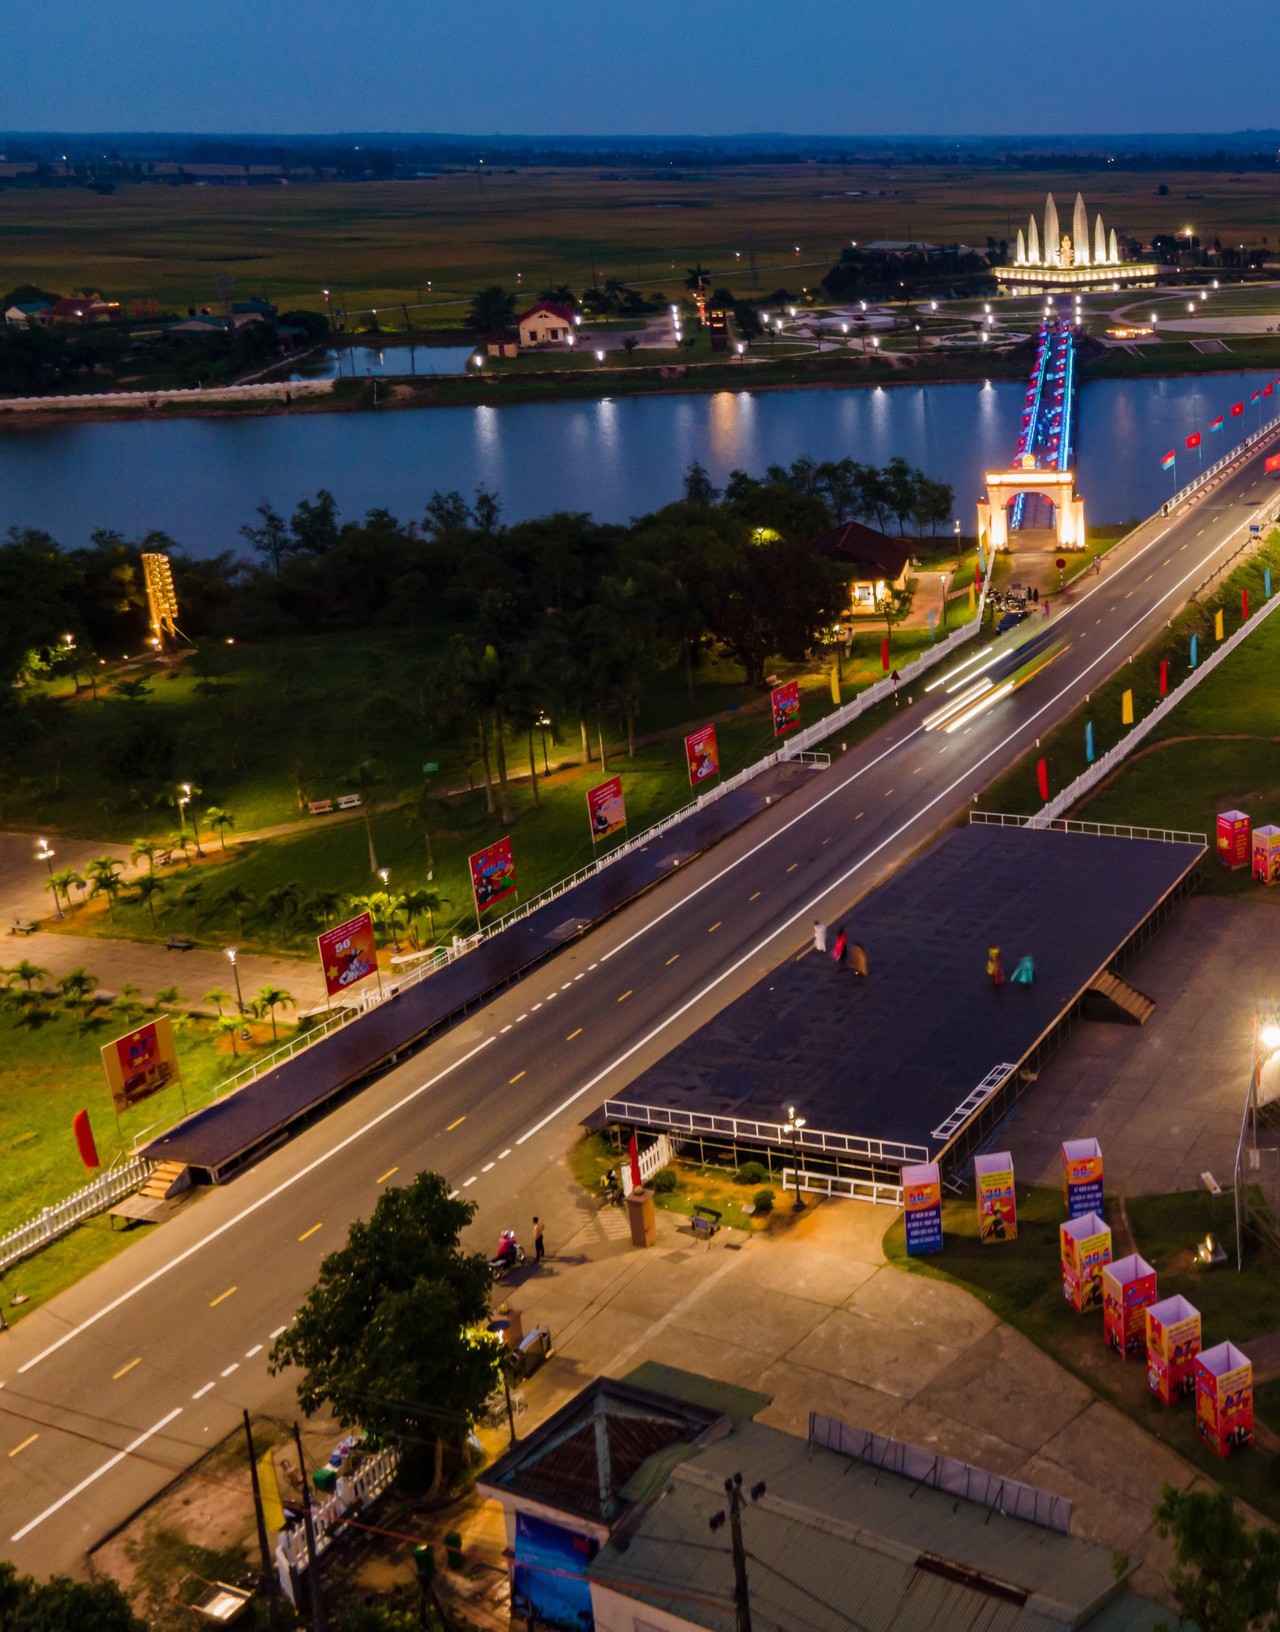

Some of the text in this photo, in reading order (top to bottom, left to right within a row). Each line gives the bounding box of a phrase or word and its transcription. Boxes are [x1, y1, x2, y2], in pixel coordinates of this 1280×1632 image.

[334, 938, 351, 953] 50
[1174, 1340, 1192, 1356] 47
[1225, 1390, 1244, 1407] 47
